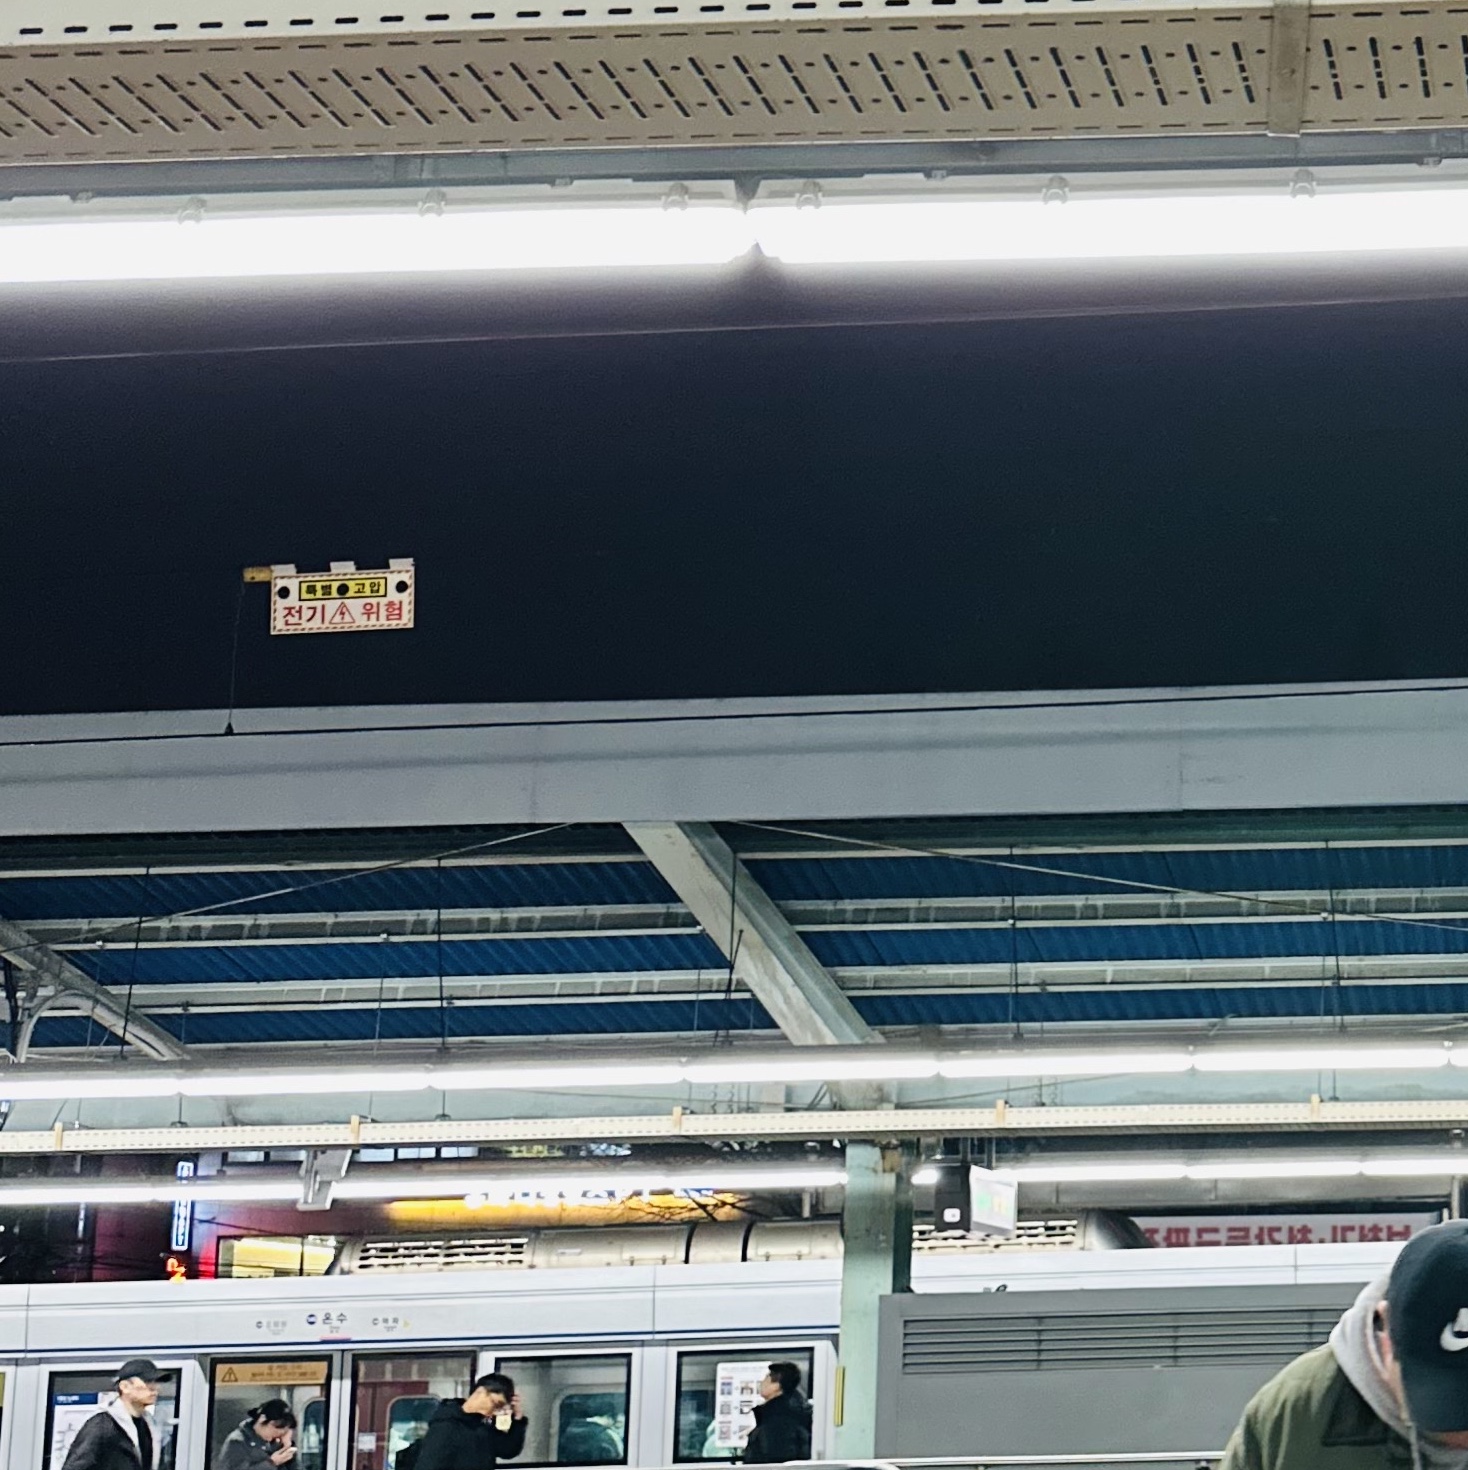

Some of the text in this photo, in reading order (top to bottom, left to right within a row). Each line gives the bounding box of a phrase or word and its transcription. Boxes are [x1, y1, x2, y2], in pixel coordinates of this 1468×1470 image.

[305, 581, 381, 597] 특별 고압
[283, 600, 403, 626] 전기 위험
[322, 1312, 348, 1325] 온수
